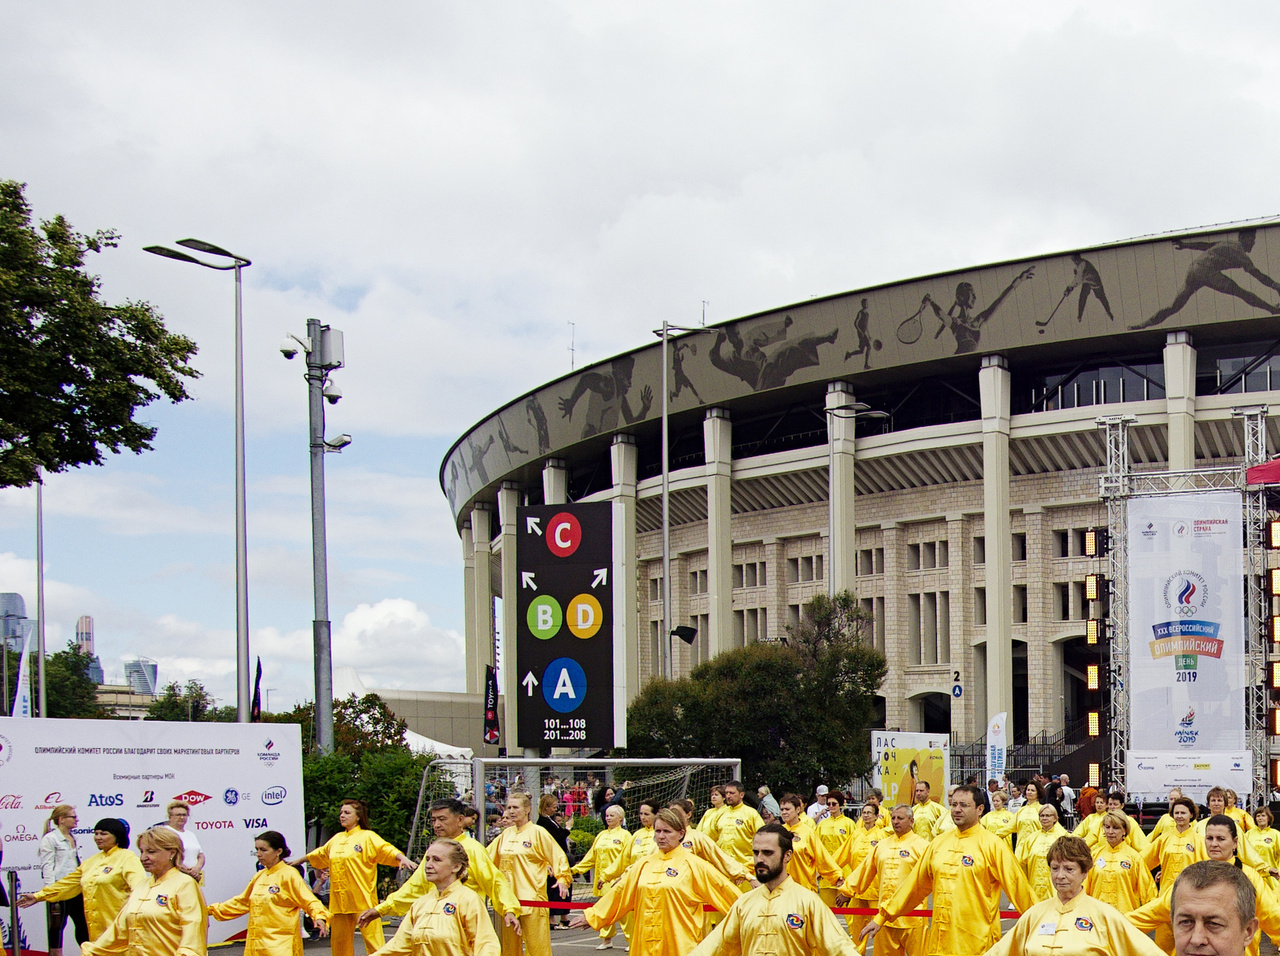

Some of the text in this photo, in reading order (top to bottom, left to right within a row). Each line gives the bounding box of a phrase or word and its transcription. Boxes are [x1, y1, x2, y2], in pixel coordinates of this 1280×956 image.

[554, 522, 571, 548] C
[537, 604, 594, 630] B D
[1168, 624, 1214, 634] ВСЕРОССИЙСКИЙ
[1154, 638, 1218, 654] ОЛИМПИЙСКИЙ
[1178, 658, 1194, 666] ДЕНЬ
[954, 671, 960, 682] 2
[1176, 672, 1197, 682] 2019
[553, 668, 576, 699] A
[34, 746, 76, 754] ОЛИМПИЙСКИЙ
[264, 790, 283, 799] intel
[195, 820, 234, 830] TOYOTA
[243, 818, 268, 828] VISA
[4, 834, 38, 842] OMEGA
